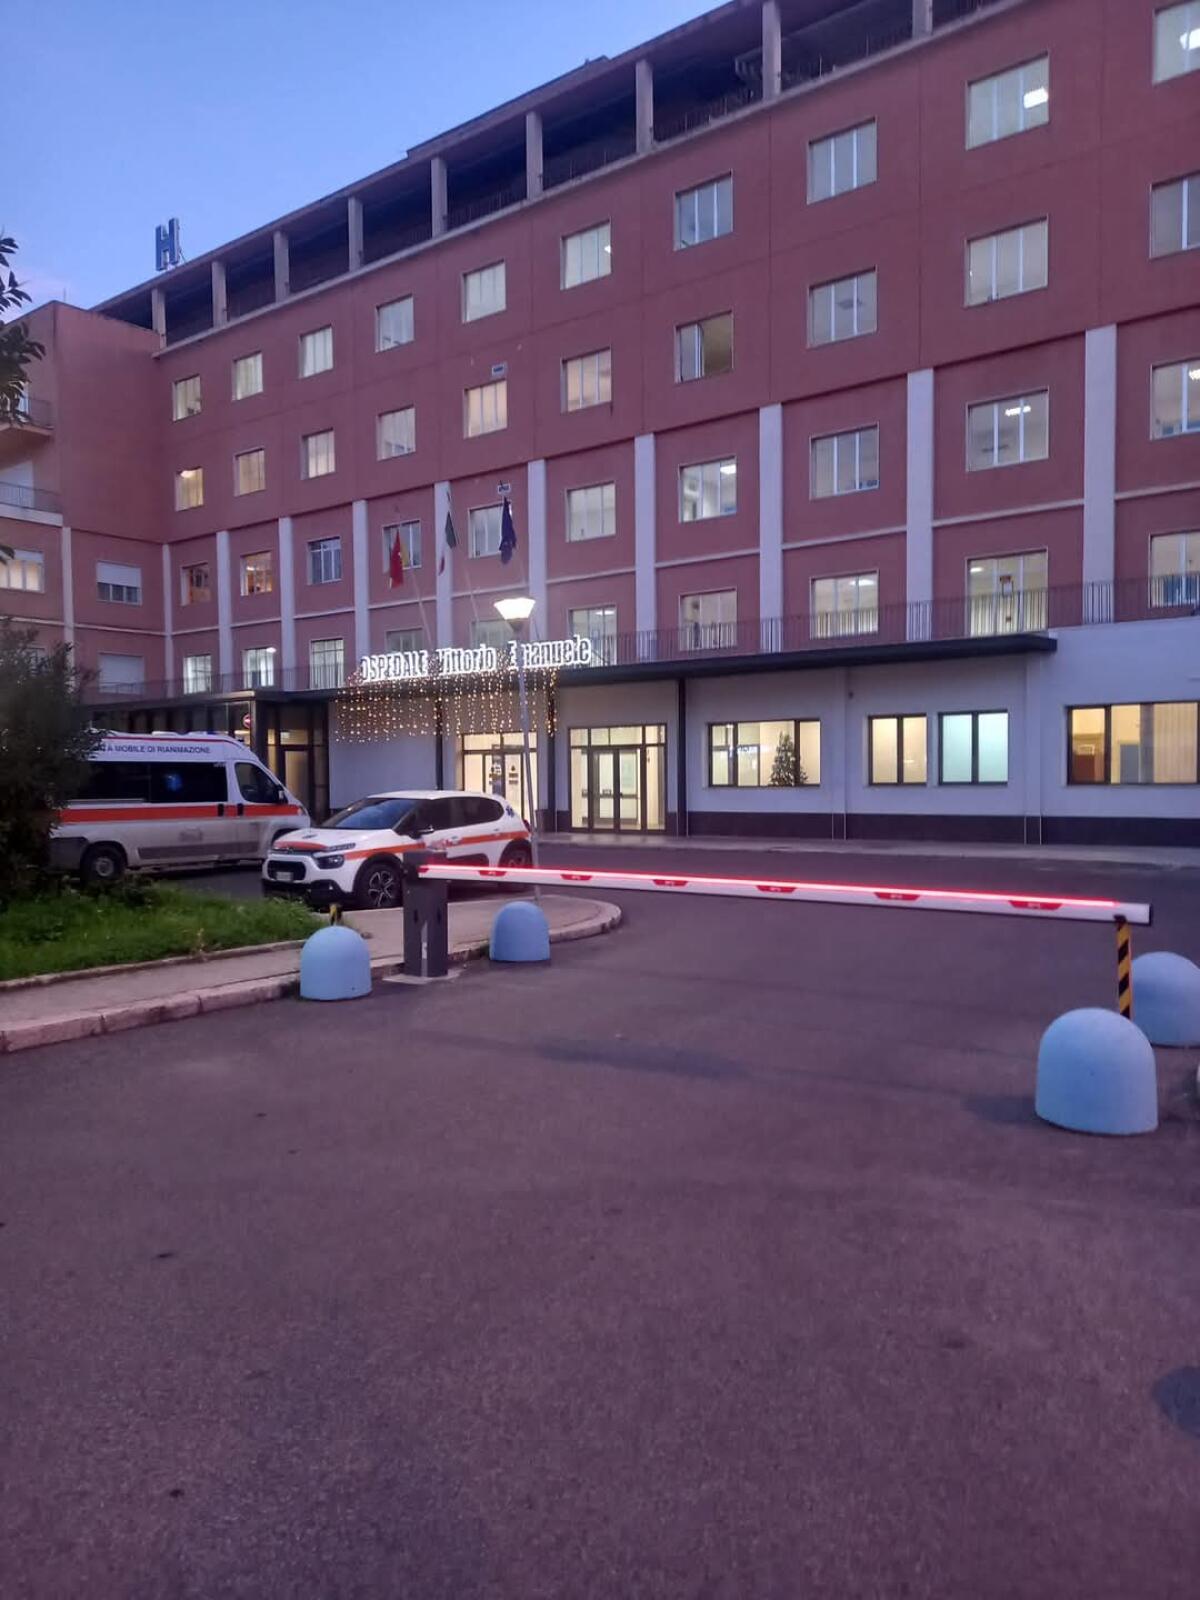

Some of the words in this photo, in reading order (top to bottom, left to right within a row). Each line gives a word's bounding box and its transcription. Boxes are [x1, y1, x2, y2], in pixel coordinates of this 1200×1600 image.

[155, 218, 178, 271] H
[361, 649, 428, 682] OSPEDALE
[115, 744, 145, 752] MOBILE
[147, 745, 155, 753] DI
